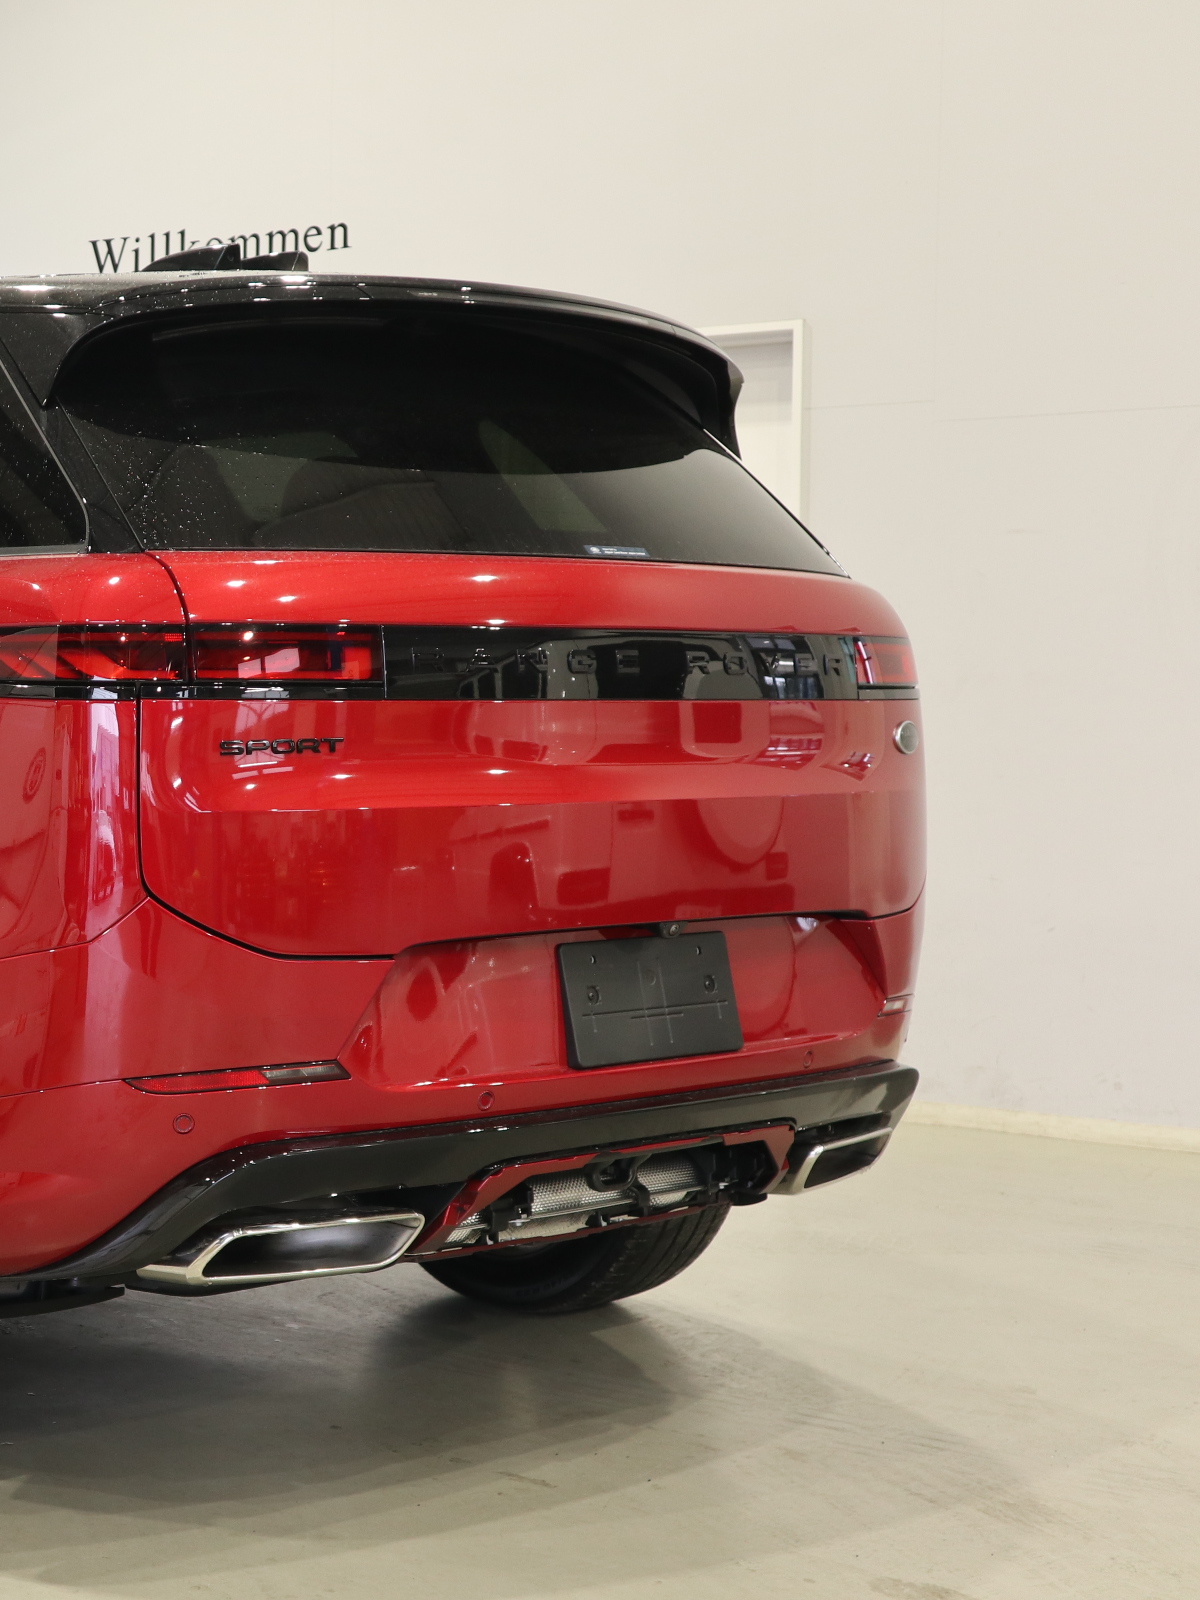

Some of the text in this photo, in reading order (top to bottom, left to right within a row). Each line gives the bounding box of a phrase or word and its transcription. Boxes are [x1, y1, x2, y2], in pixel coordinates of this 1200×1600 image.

[412, 648, 844, 676] RANGE ROVER
[220, 737, 344, 755] SPORT
